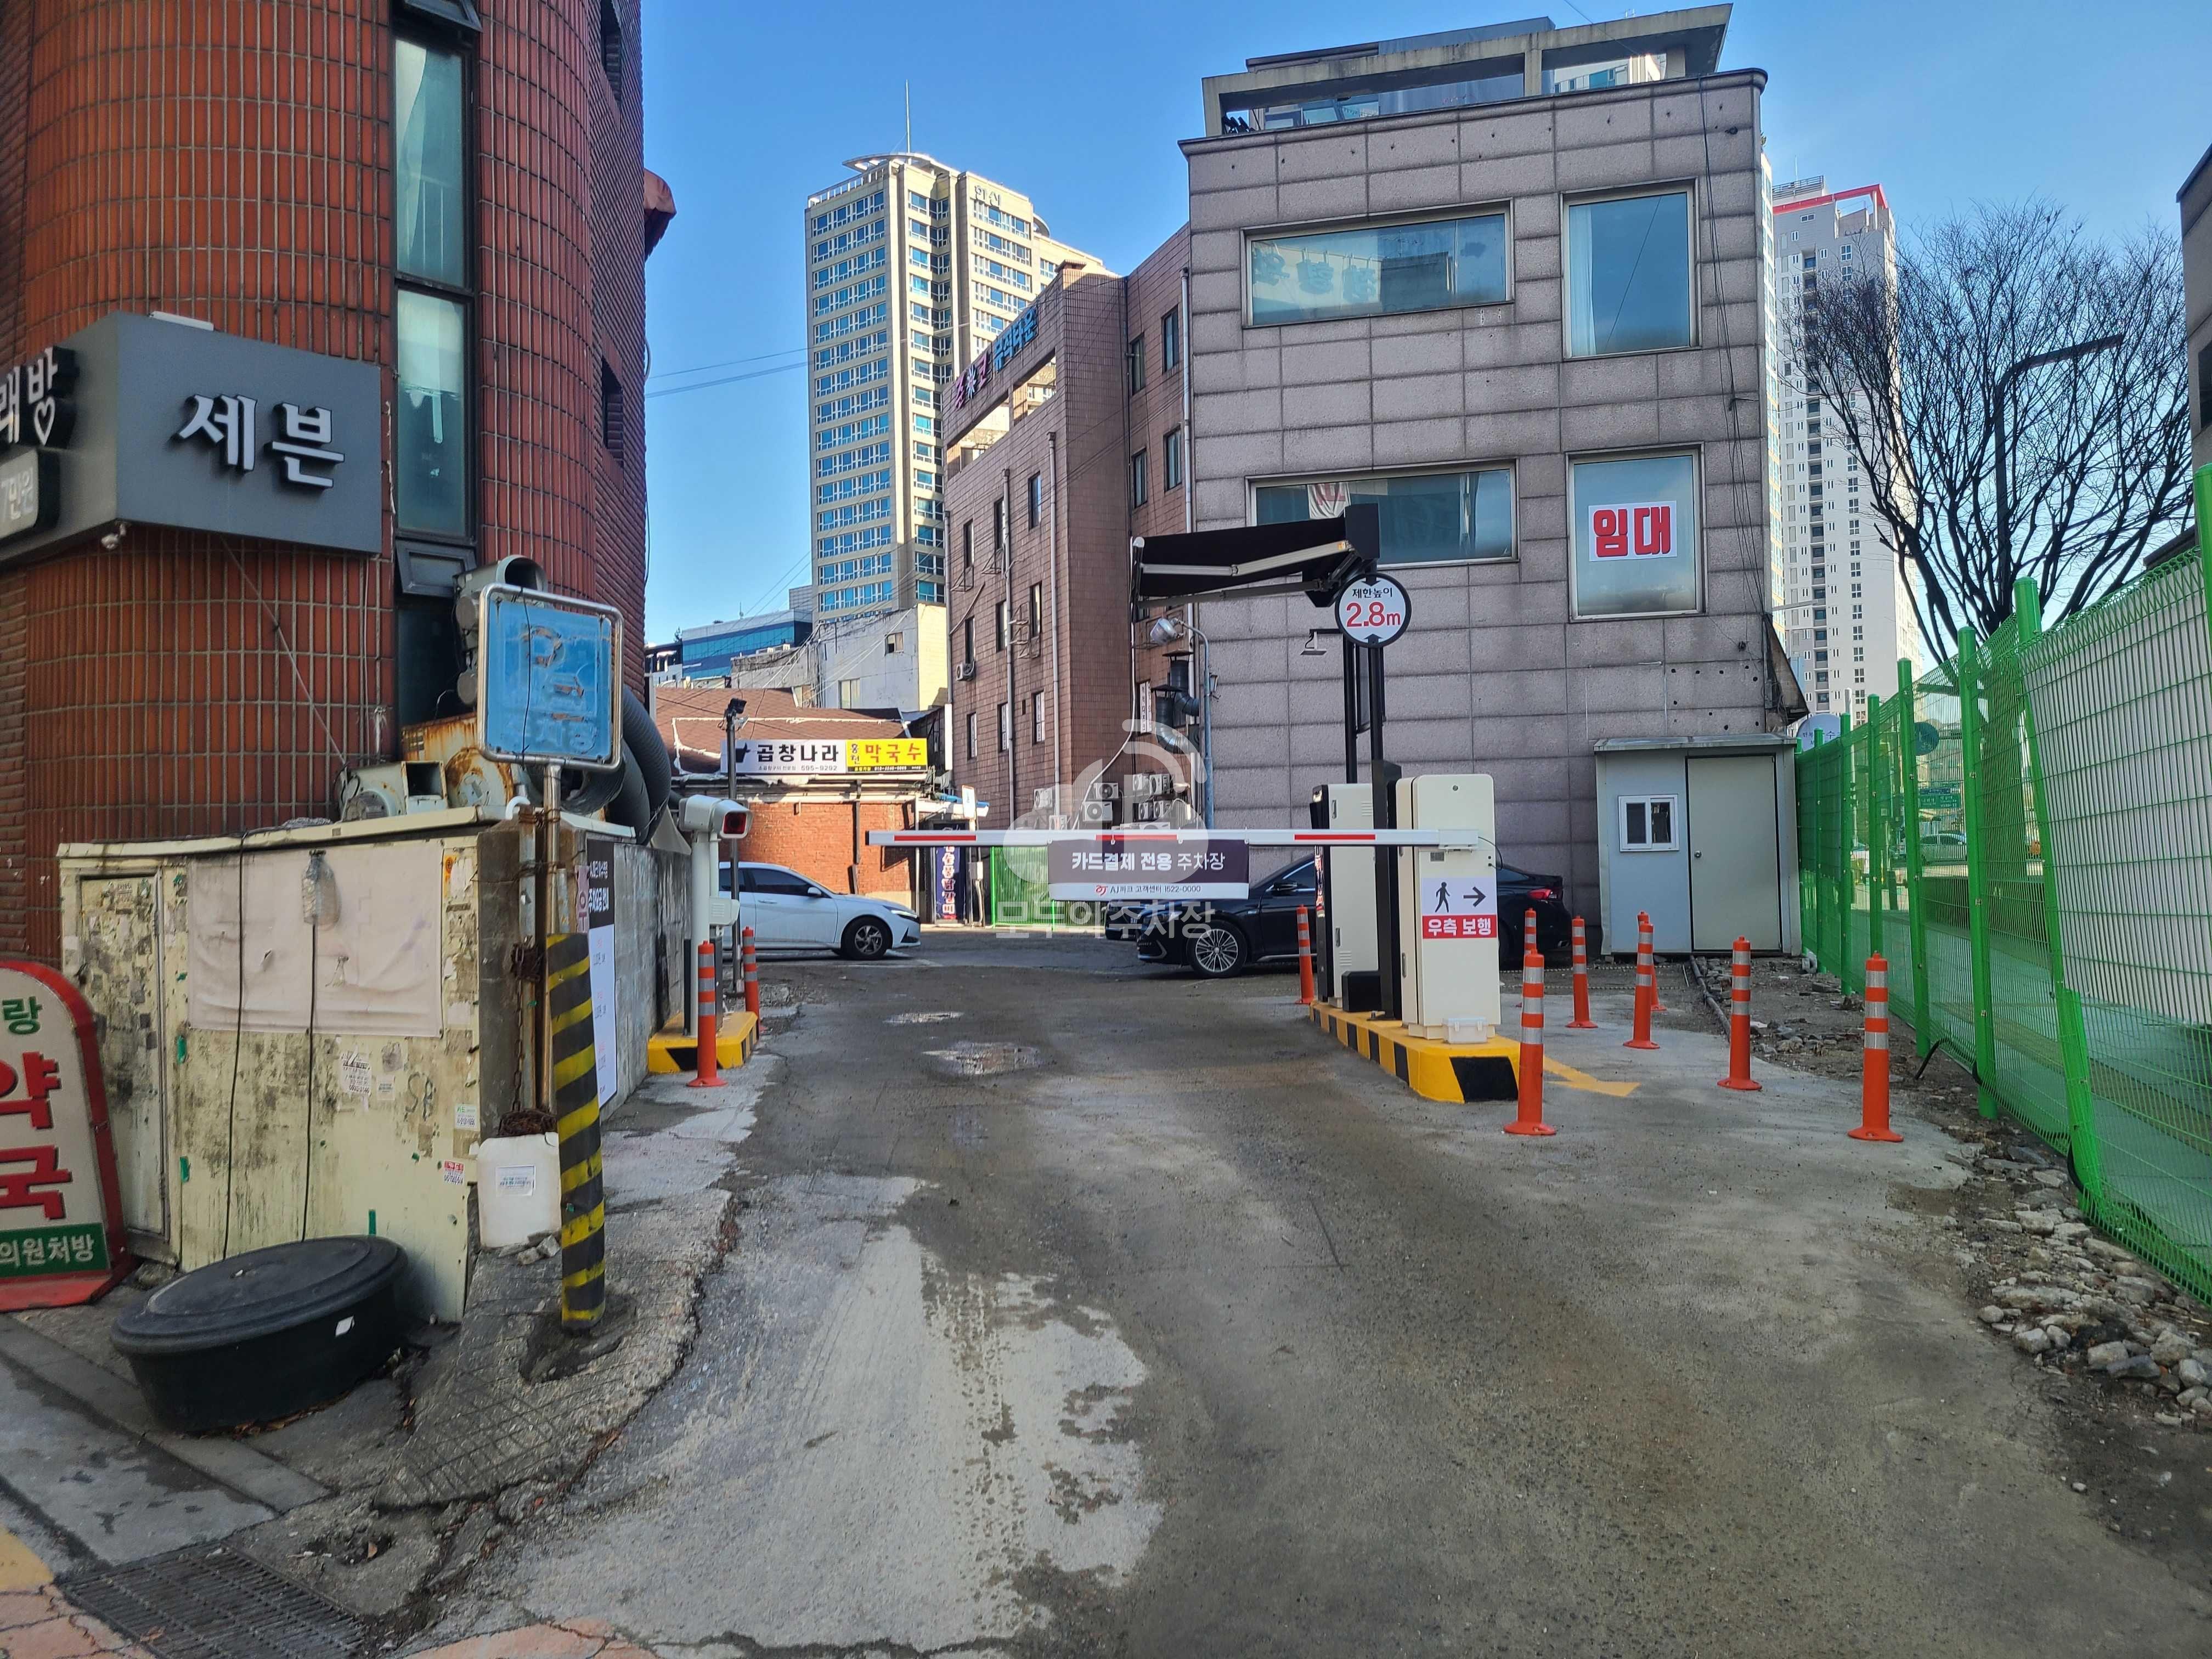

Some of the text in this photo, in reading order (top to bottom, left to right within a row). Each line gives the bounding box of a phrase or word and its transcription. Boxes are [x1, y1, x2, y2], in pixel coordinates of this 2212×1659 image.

[179, 394, 345, 489] 세븐
[1593, 506, 1671, 558] 임대
[1352, 587, 1392, 599] 제한높이
[1346, 601, 1401, 627] 2.8m
[757, 744, 839, 762] 곱창나라
[865, 743, 922, 763] 막국수
[1071, 852, 1226, 871] 카드결제 전용 주차장
[1428, 918, 1492, 936] 우측 보행
